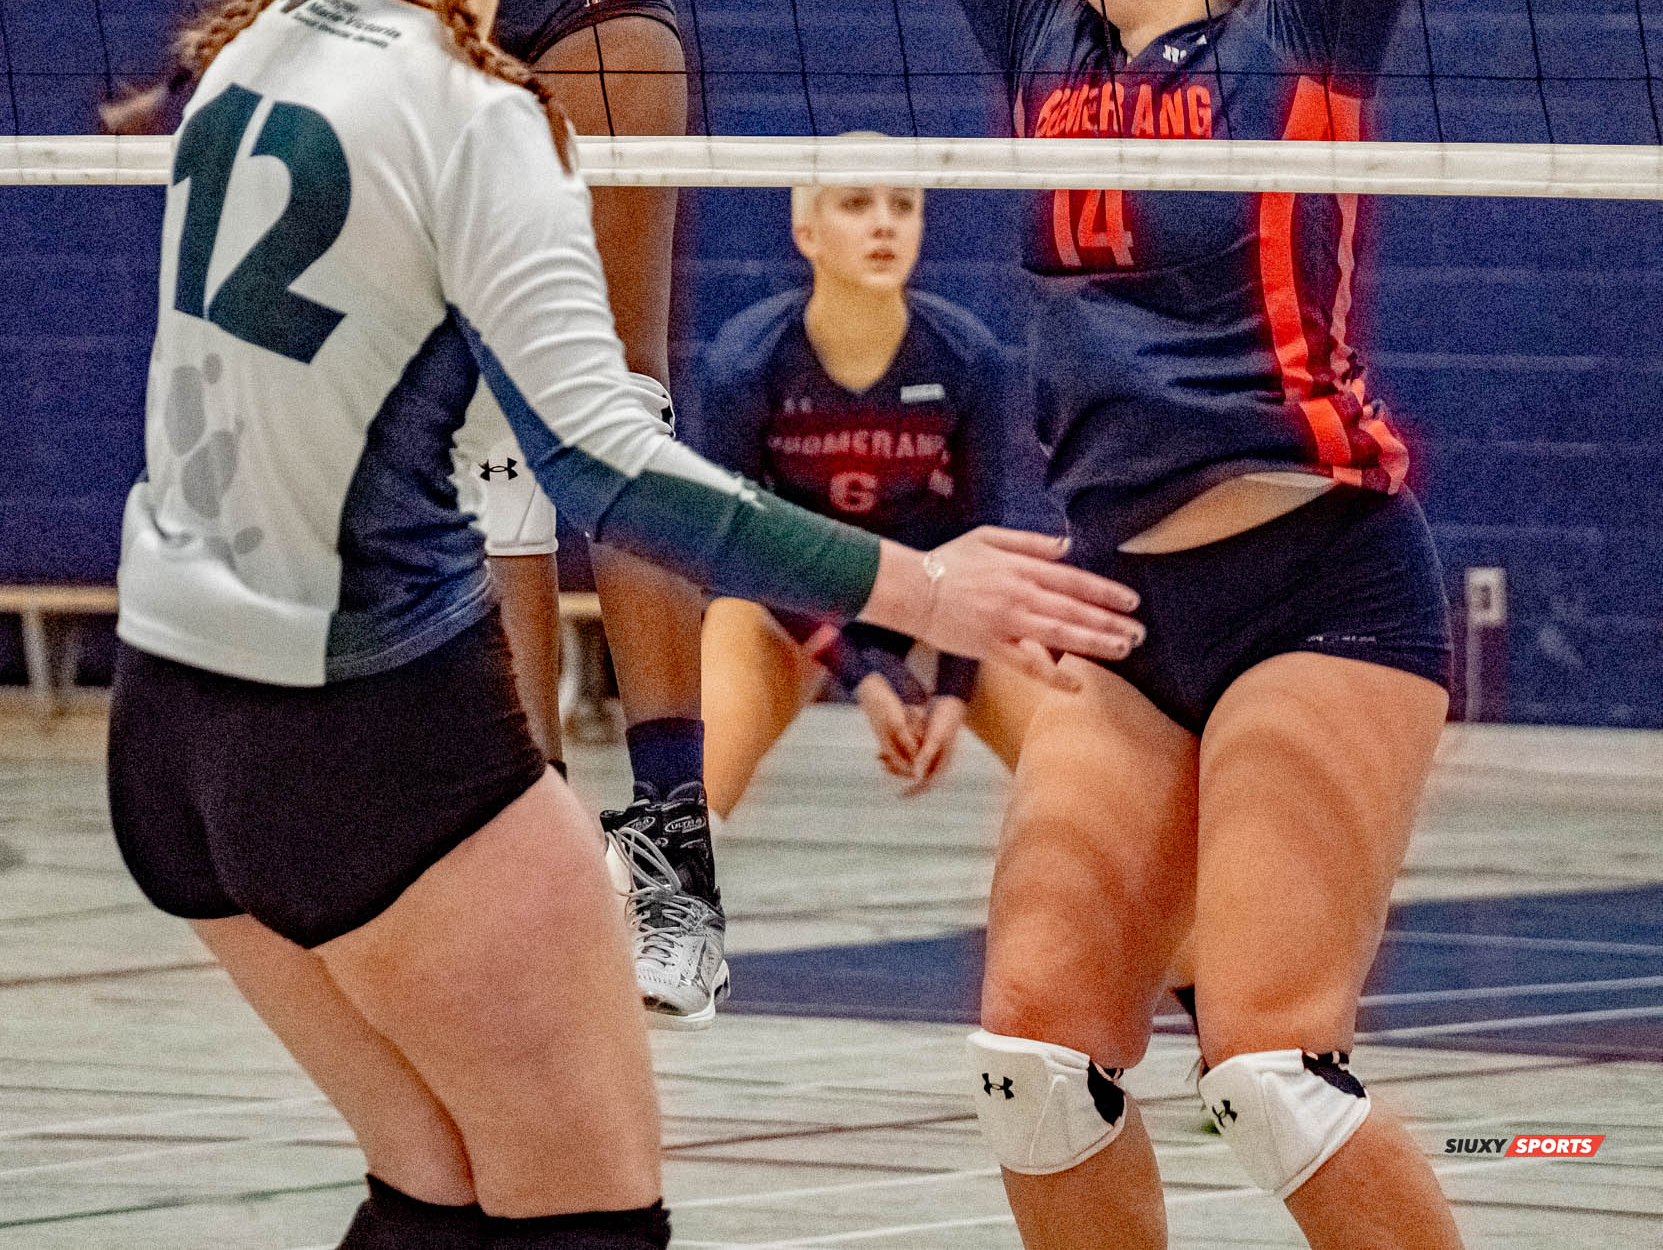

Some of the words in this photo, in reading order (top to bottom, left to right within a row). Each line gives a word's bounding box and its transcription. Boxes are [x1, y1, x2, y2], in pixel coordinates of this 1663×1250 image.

[172, 82, 352, 365] 12
[1053, 188, 1135, 267] 14
[829, 470, 878, 513] 6
